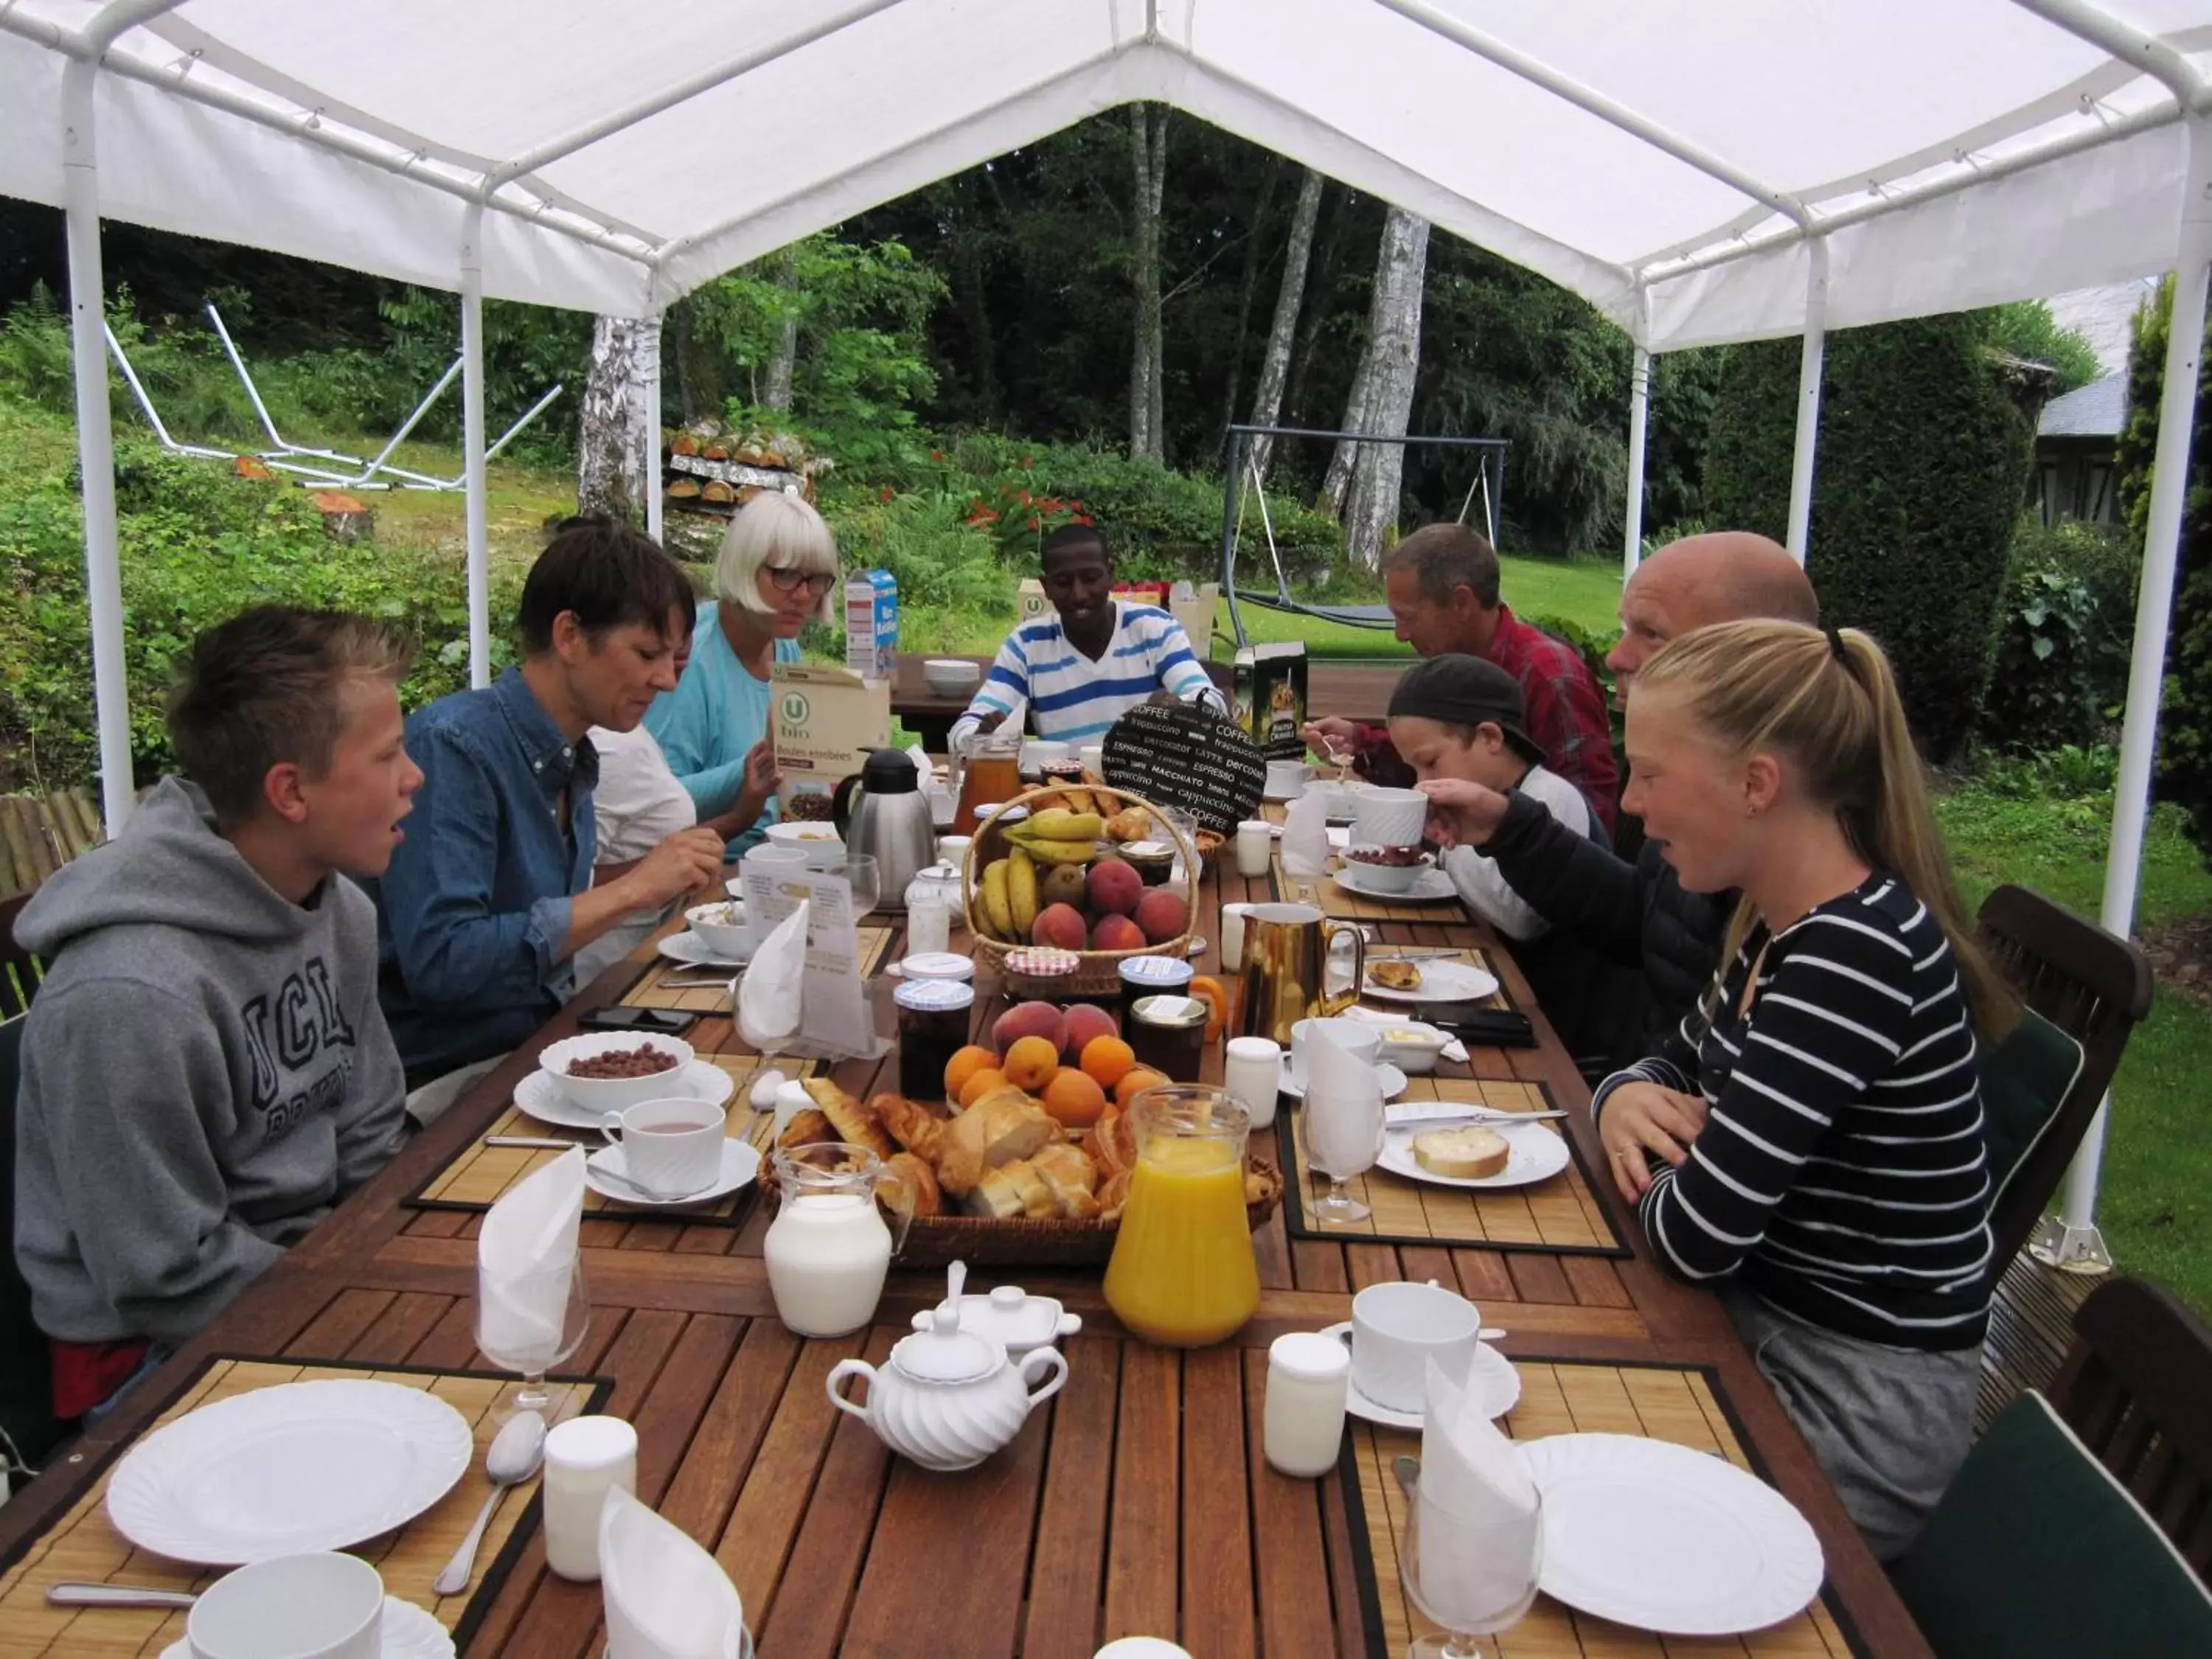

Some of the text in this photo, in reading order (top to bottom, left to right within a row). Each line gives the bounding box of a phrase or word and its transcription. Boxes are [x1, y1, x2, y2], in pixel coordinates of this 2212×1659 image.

[1027, 600, 1039, 611] U
[786, 700, 803, 718] U
[1113, 741, 1154, 757] ESPRESSO
[1193, 761, 1235, 783] ESPRESSO
[1195, 748, 1222, 764] LATTE
[1151, 765, 1204, 787] MACCHIATO
[1178, 788, 1235, 813] cappuccino
[1189, 807, 1229, 830] COFFEE
